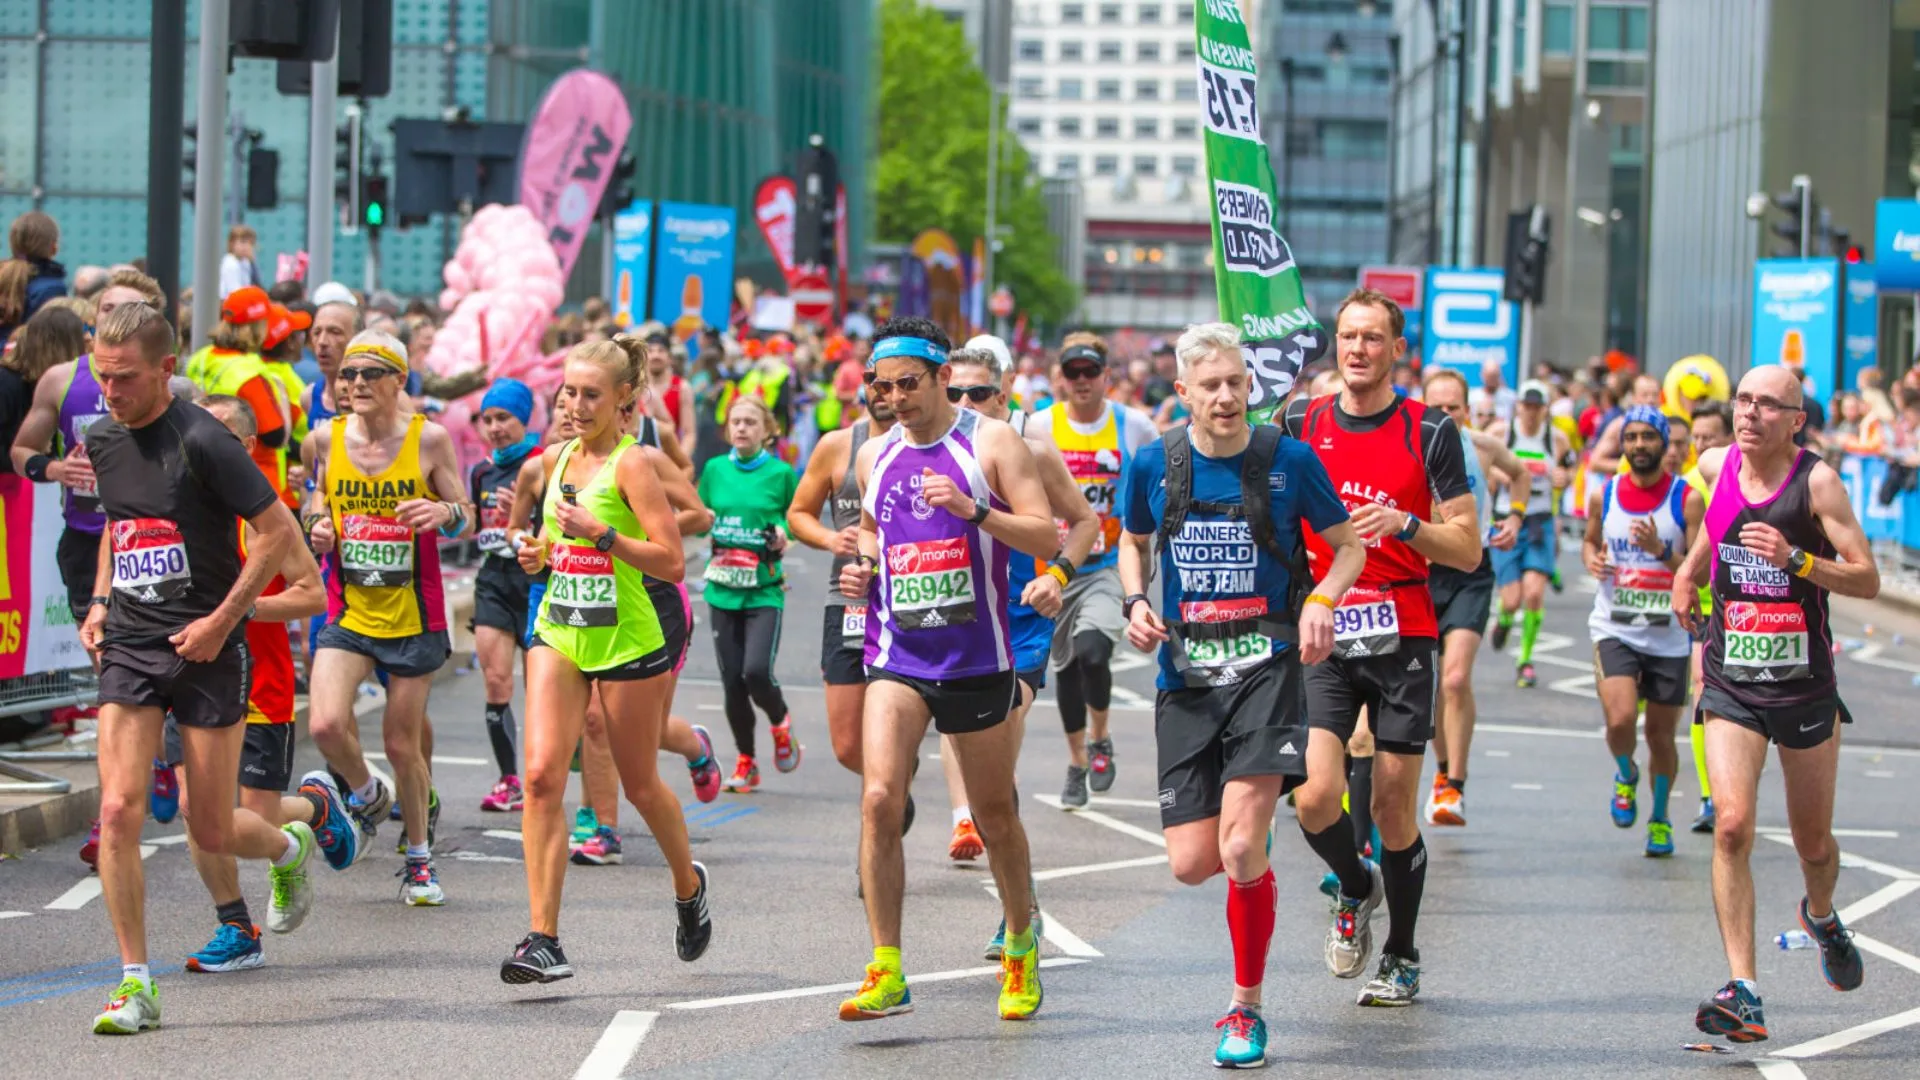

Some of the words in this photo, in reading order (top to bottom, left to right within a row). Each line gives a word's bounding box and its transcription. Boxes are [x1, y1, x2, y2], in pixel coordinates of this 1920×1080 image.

[335, 479, 415, 498] JULIAN
[1340, 480, 1398, 509] ALLES
[881, 480, 904, 523] CITY
[371, 522, 408, 535] money
[118, 547, 185, 581] 60450
[342, 543, 409, 565] 26407
[570, 554, 609, 567] money
[922, 547, 965, 562] money
[1175, 545, 1251, 562] WORLD
[1719, 544, 1753, 564] YOUNG
[893, 570, 971, 604] 26942
[1213, 569, 1254, 593] TEAM
[1745, 568, 1788, 585] CANCER
[552, 574, 613, 602] 28132
[1613, 589, 1671, 608] 30970
[1217, 605, 1263, 619] money
[1729, 603, 1757, 630] Virgin
[1760, 611, 1804, 625] money
[1727, 634, 1801, 661] 28921
